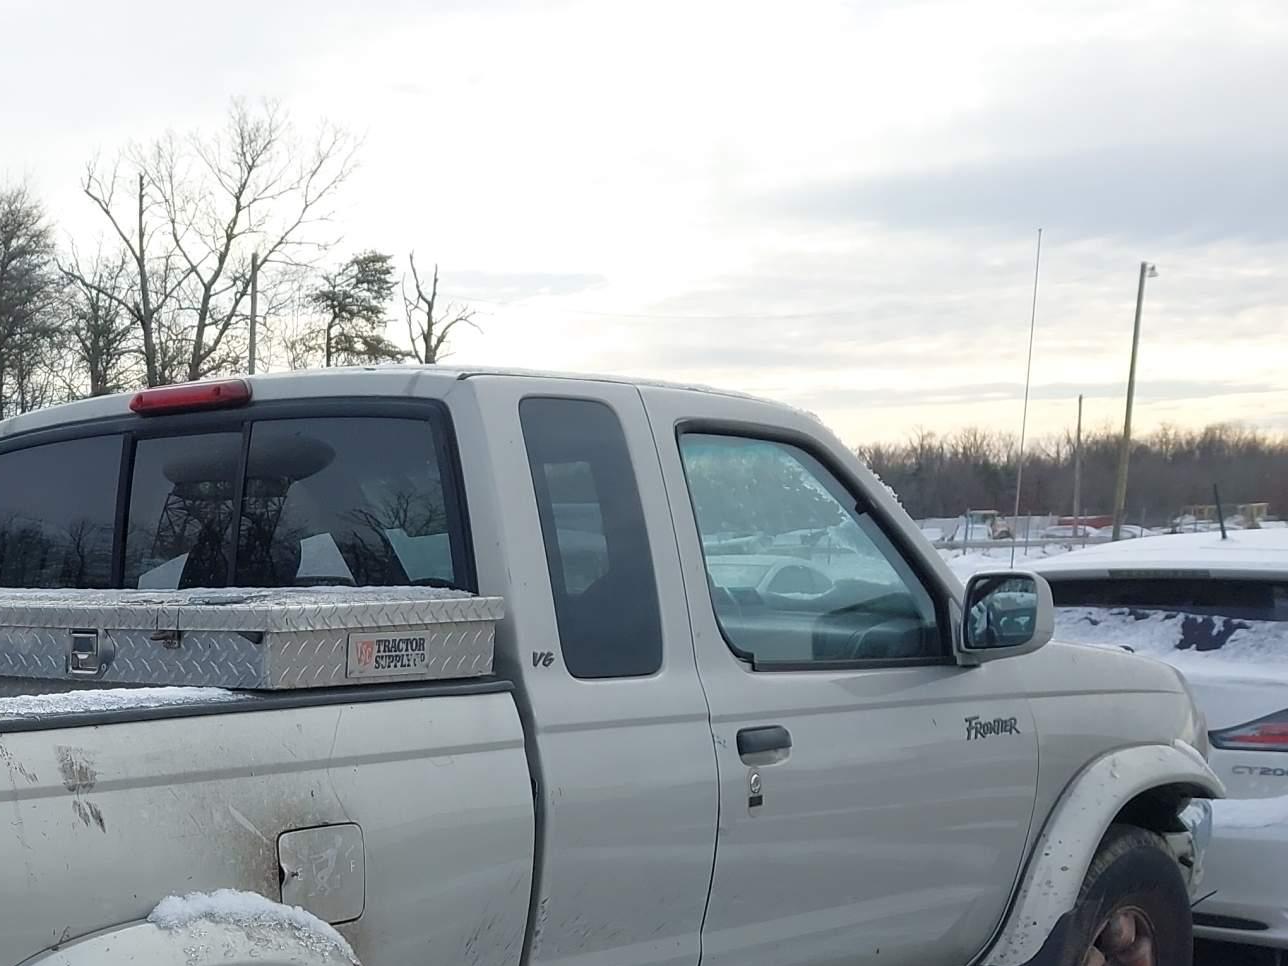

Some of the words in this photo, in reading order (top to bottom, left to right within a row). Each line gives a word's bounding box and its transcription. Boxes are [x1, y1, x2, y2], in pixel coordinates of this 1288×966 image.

[376, 638, 426, 653] TRACTOR
[532, 651, 554, 667] V6
[964, 716, 1020, 740] FRONTIER
[1232, 765, 1288, 776] CT20
